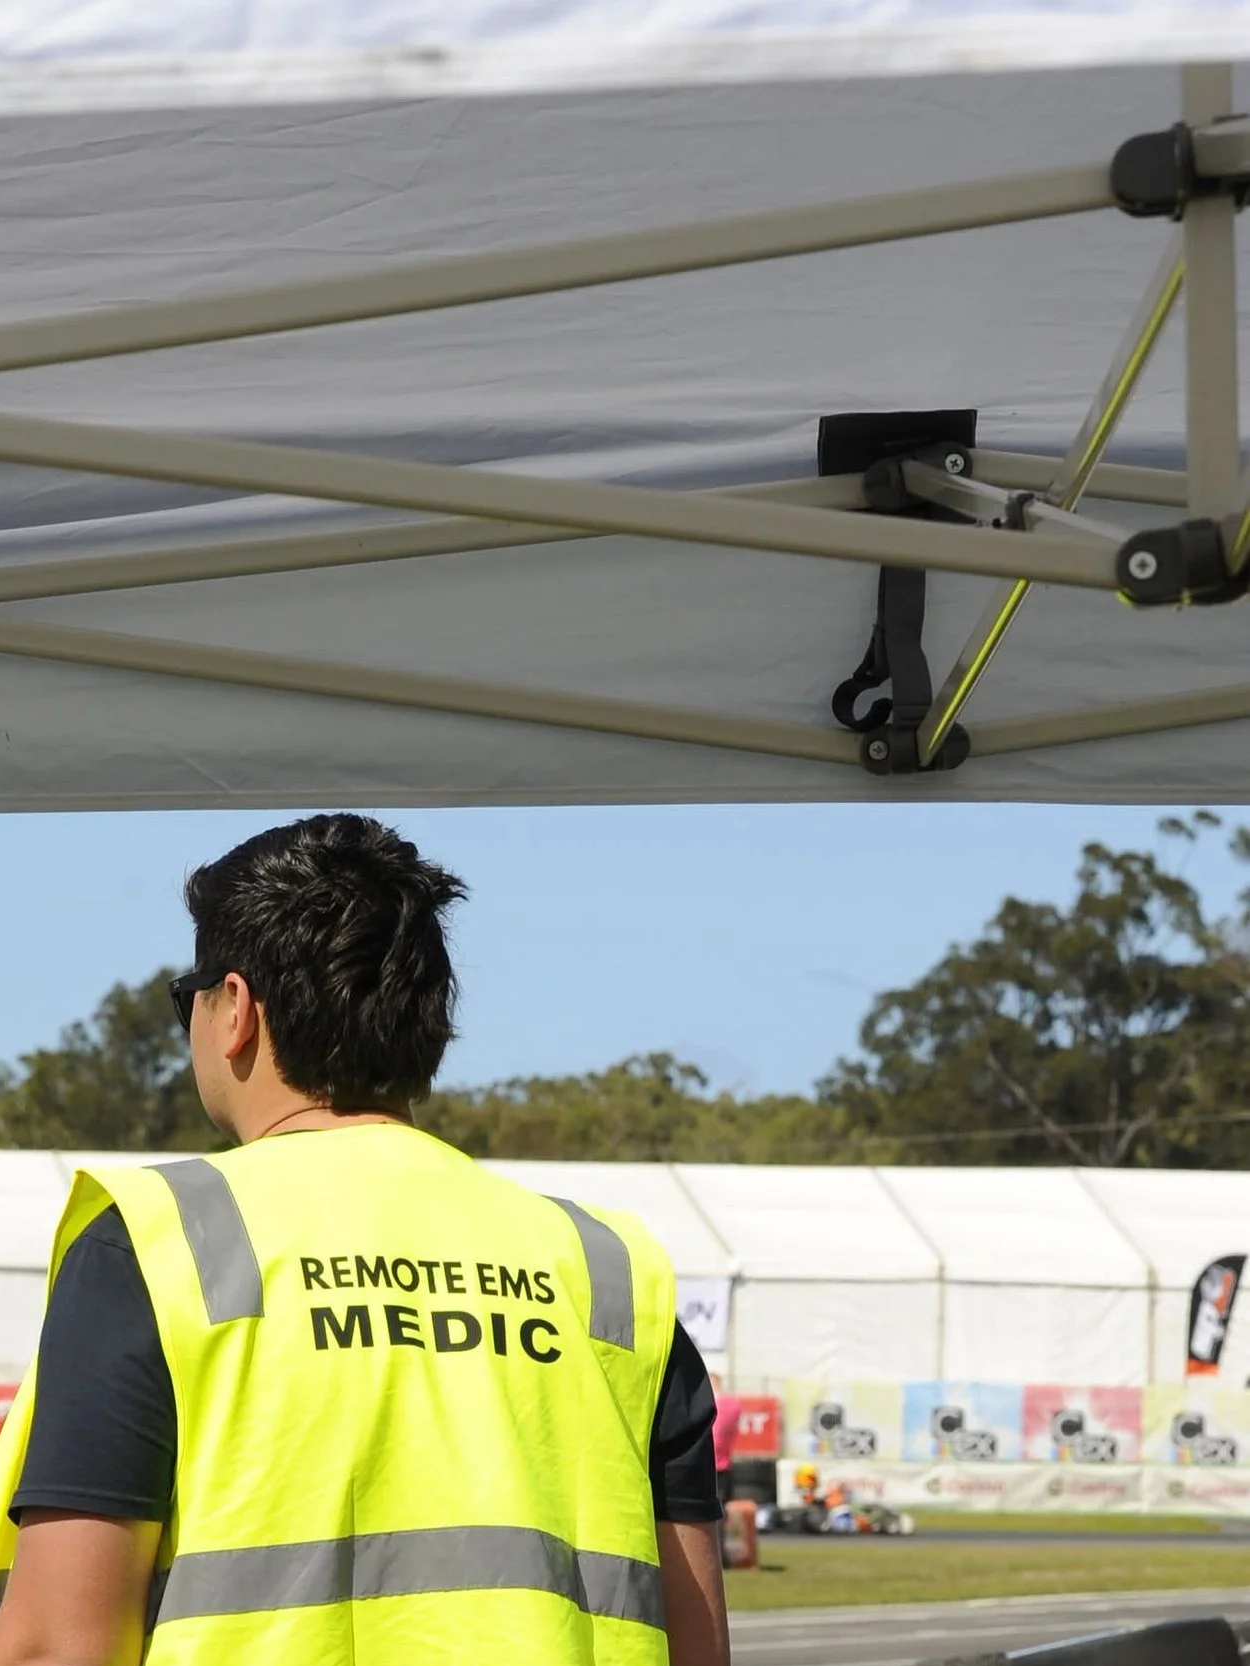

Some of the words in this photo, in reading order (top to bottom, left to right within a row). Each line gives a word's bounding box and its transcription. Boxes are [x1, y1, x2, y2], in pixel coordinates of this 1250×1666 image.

[300, 1255, 466, 1294] REMOTE
[475, 1262, 556, 1304] EMS
[310, 1304, 562, 1363] MEDIC
